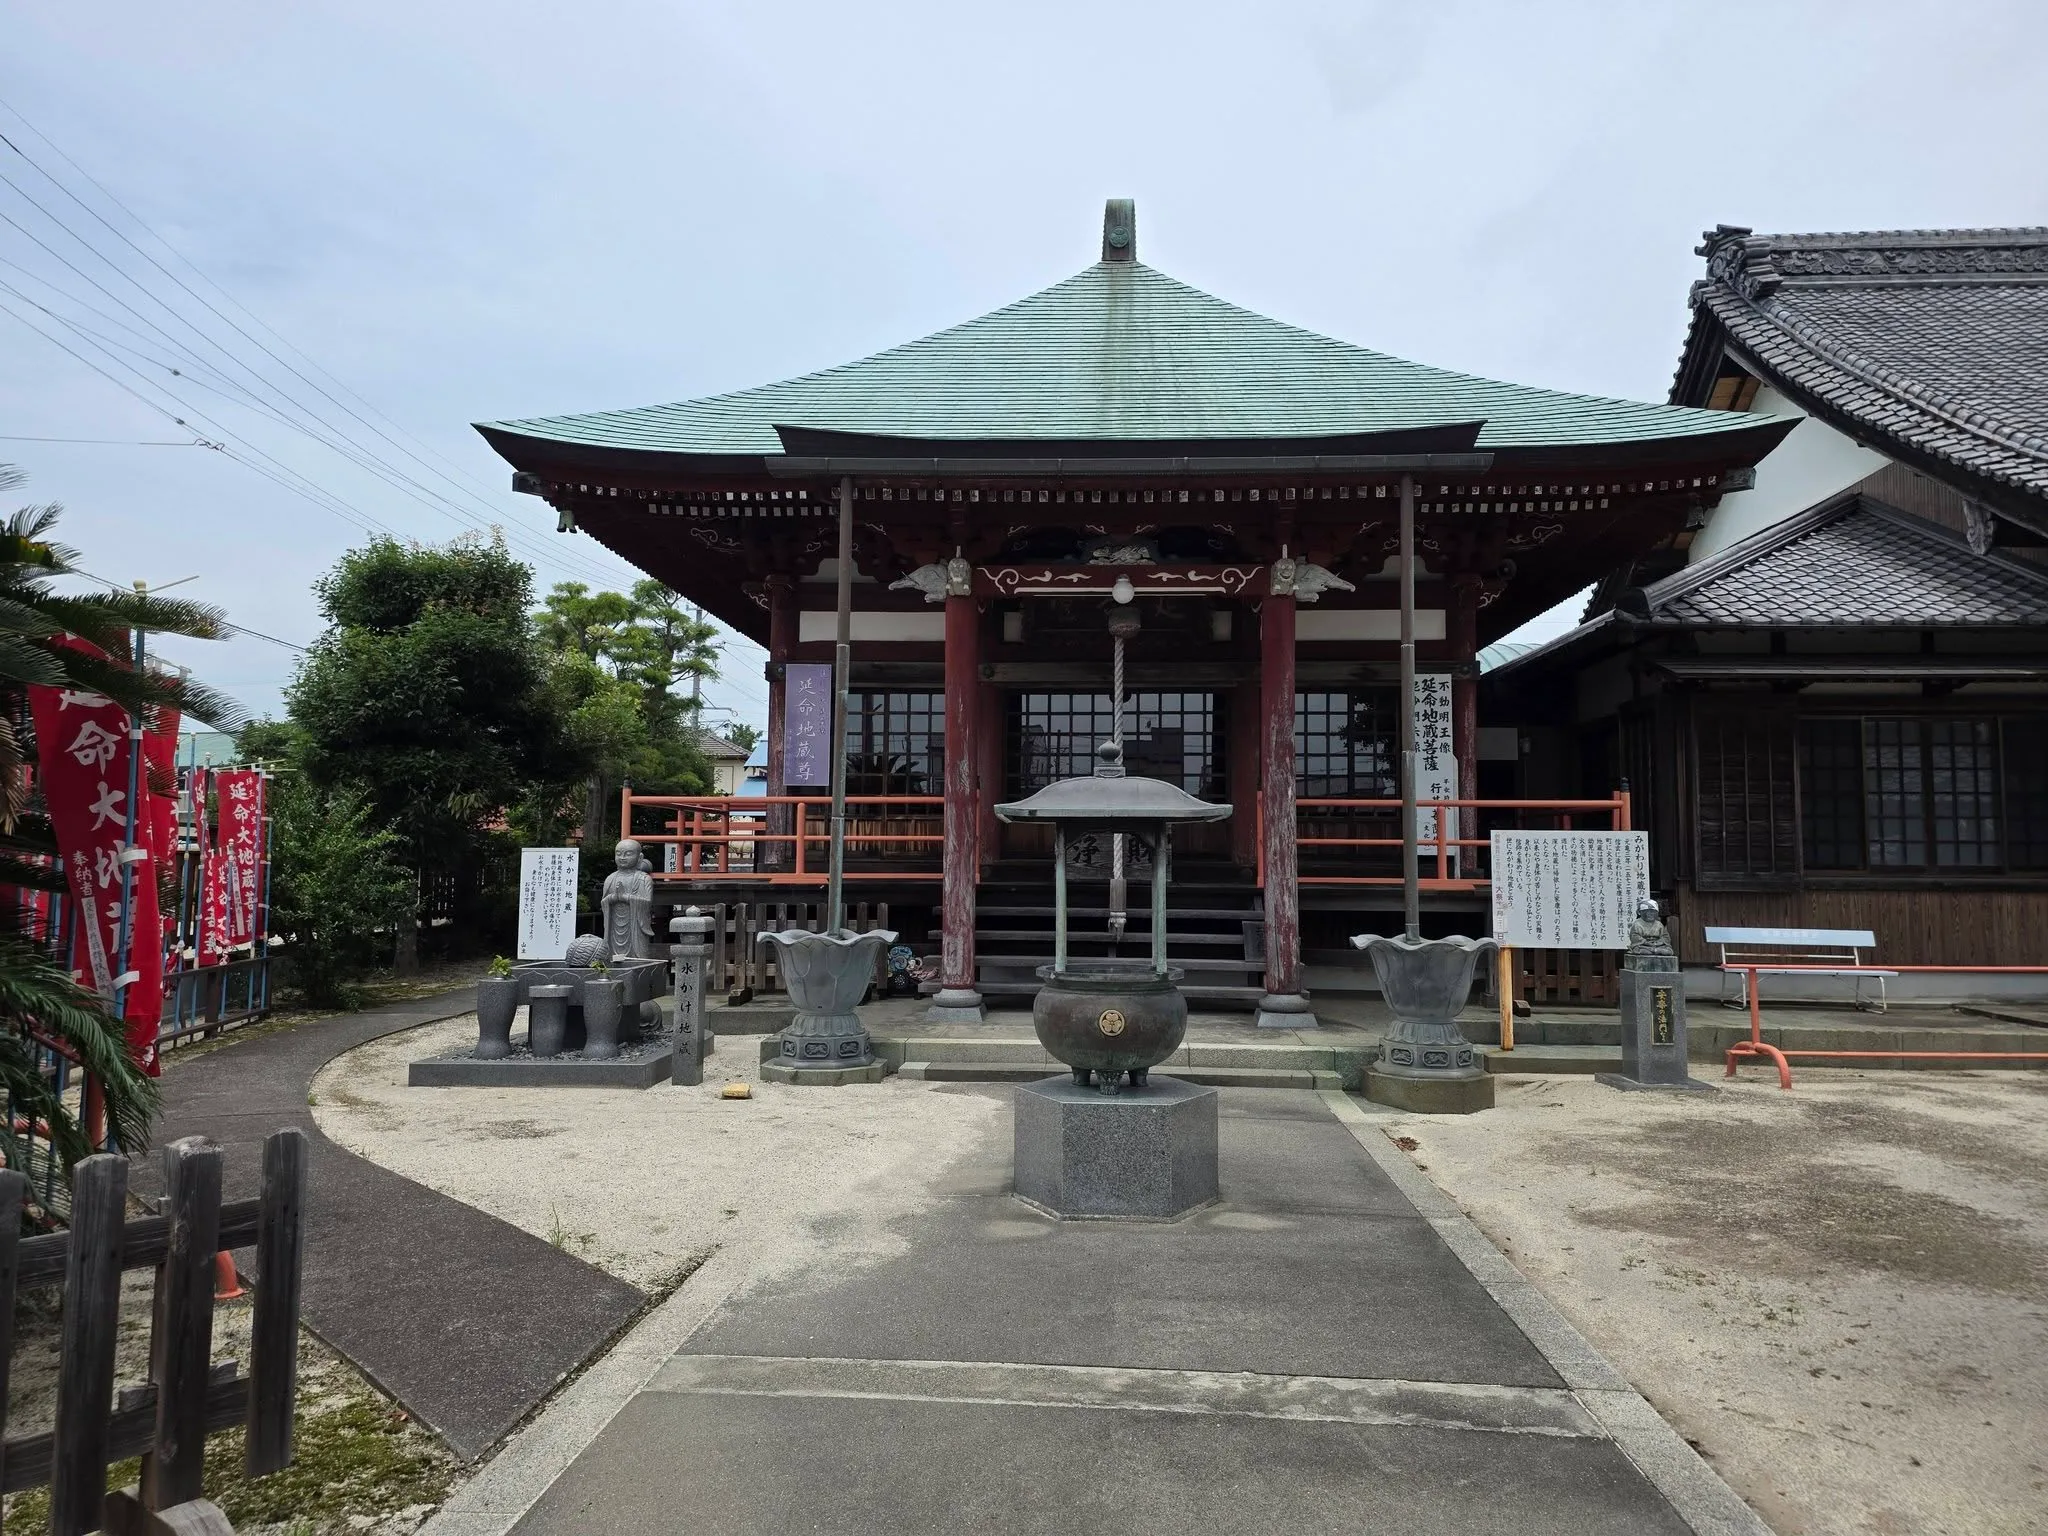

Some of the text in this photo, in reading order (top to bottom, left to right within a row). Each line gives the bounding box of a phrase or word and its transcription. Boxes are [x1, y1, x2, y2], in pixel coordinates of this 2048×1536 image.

[795, 677, 816, 781] 延命地蔵尊
[1421, 677, 1439, 772] 延命地蔵菩薩
[1438, 681, 1451, 753] 不動明王像
[73, 850, 93, 896] 奉納者
[678, 961, 694, 1057] 水かけ地蔵
